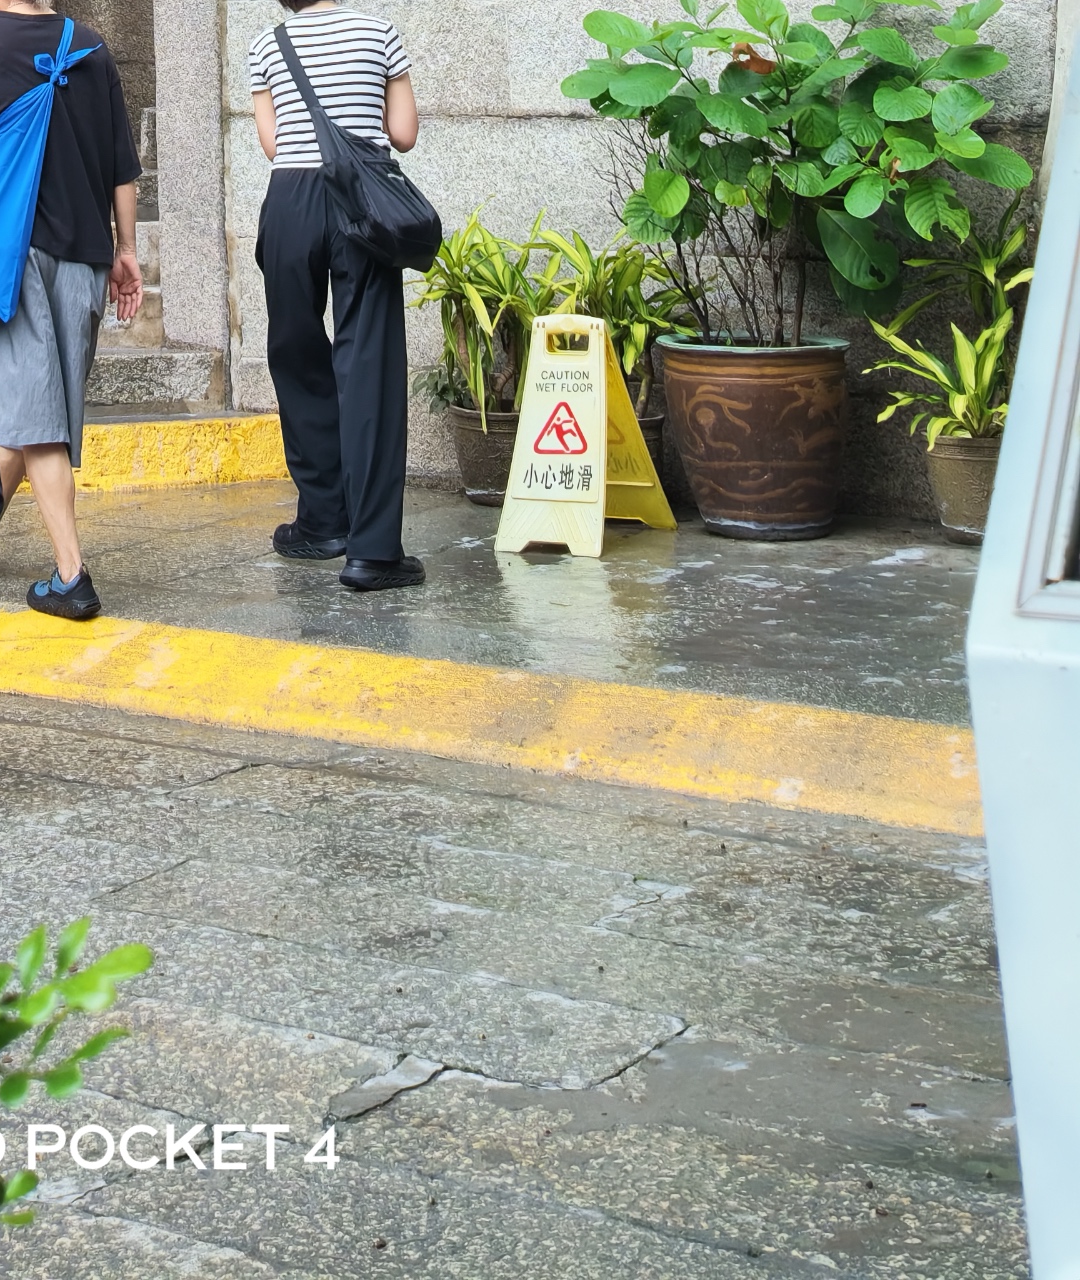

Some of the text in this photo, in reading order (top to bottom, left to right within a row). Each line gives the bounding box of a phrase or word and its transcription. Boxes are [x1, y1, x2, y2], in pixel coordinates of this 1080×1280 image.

[541, 370, 590, 380] CAUTION
[535, 382, 593, 392] WET FLOOR
[523, 462, 593, 492] 小心地滑
